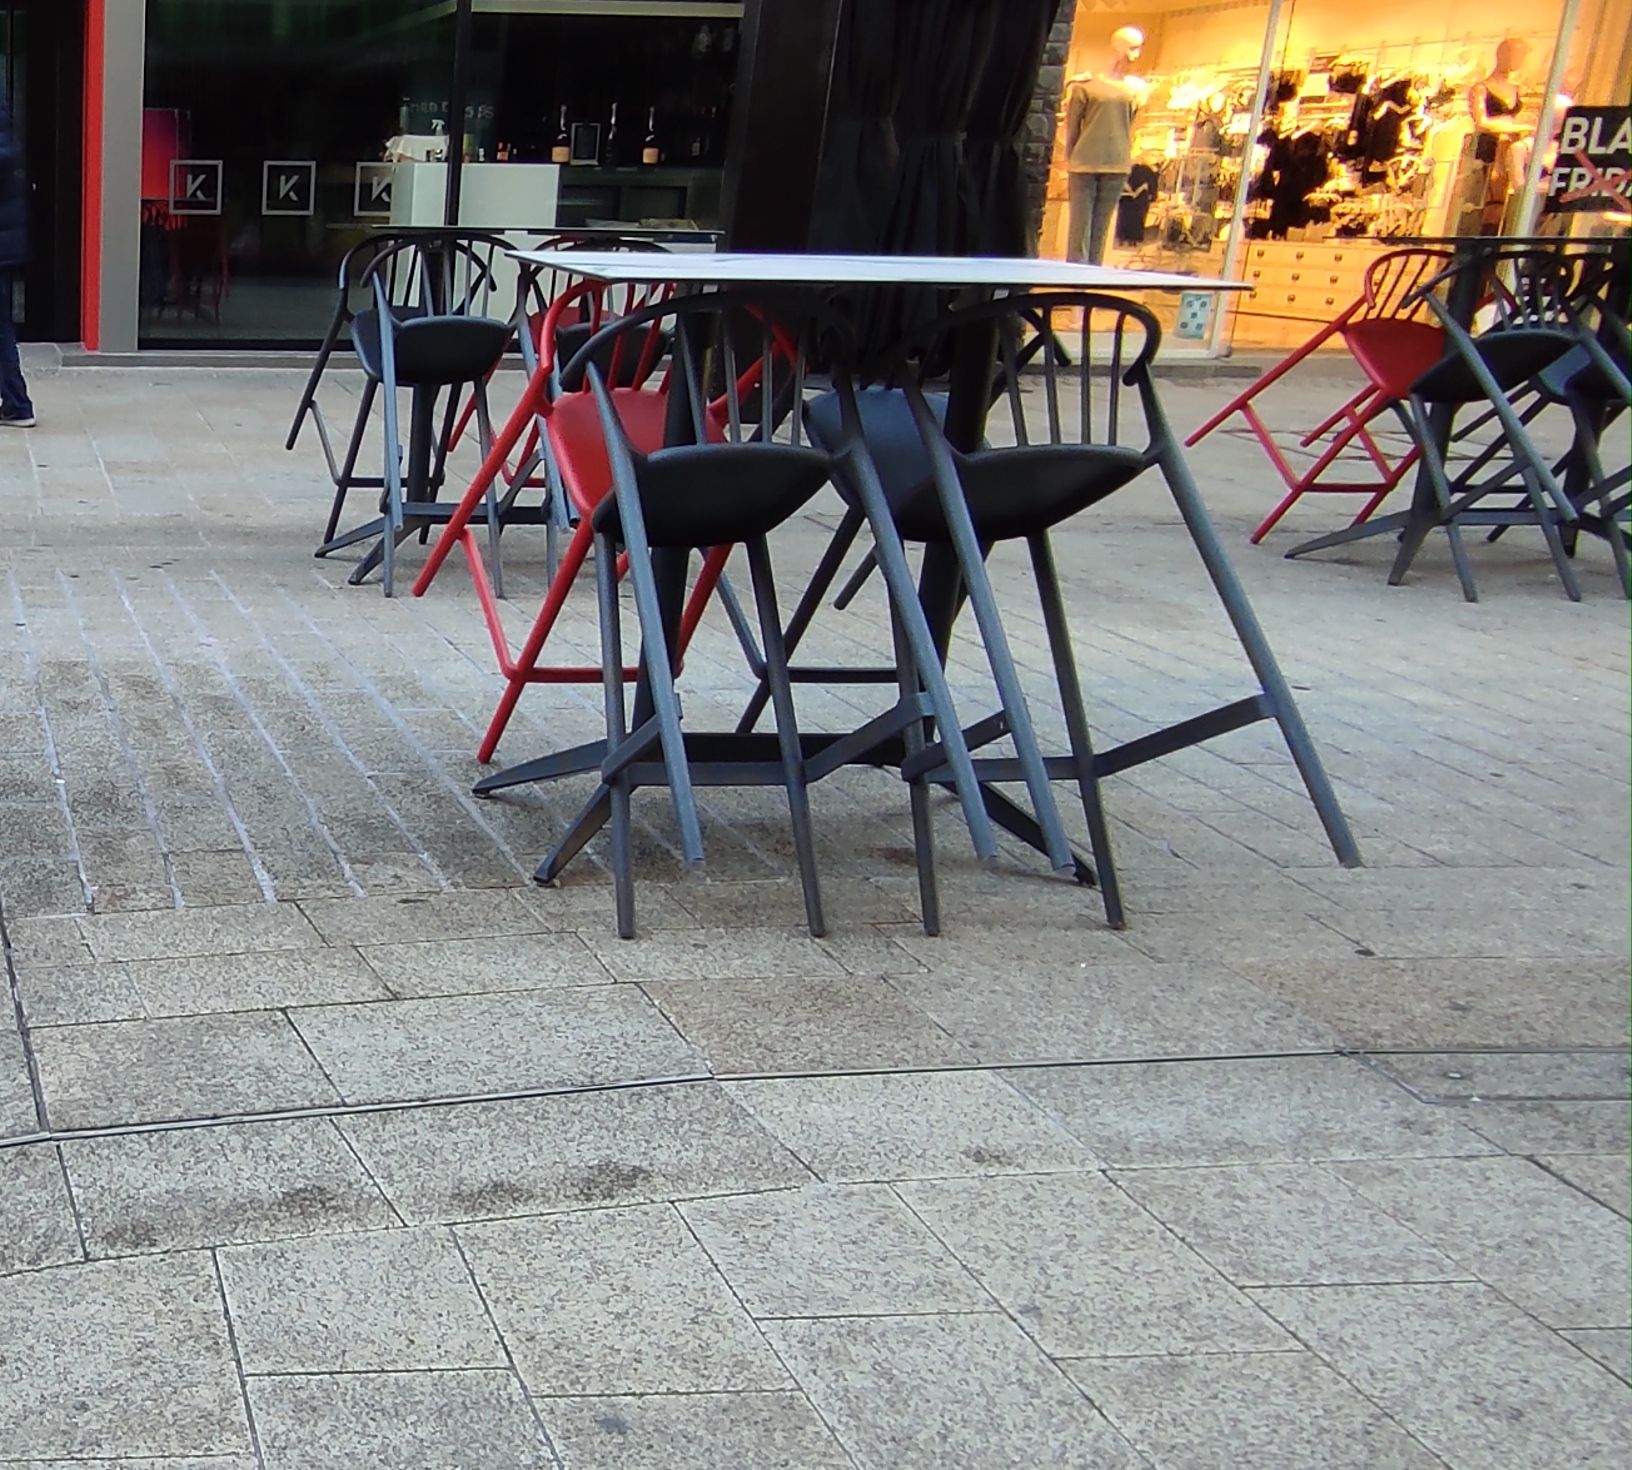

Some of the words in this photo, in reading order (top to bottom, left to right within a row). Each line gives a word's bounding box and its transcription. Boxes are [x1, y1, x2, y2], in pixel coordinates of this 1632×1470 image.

[186, 174, 207, 200] K
[279, 175, 300, 201] K
[371, 176, 392, 202] K
